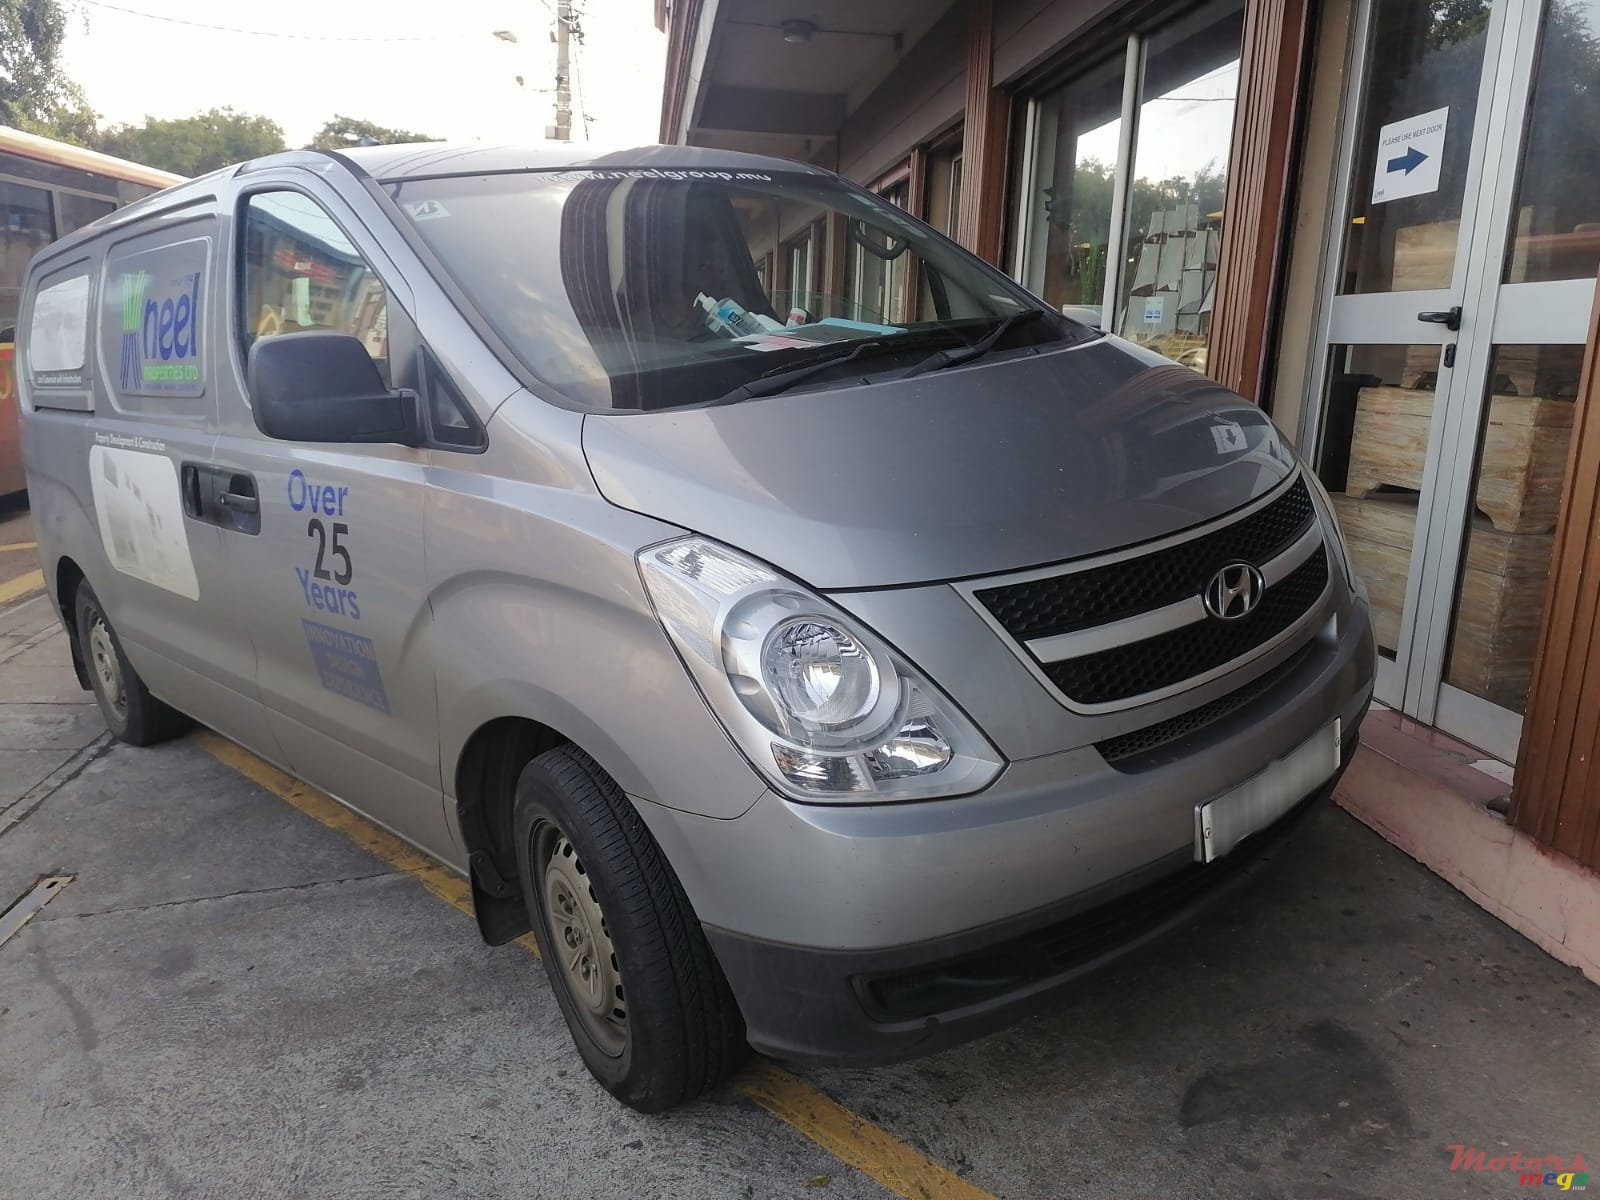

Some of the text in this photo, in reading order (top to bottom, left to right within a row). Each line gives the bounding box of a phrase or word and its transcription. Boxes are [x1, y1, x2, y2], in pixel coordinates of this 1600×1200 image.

[1382, 123, 1443, 146] PLEASE USE NEXT DOOR
[143, 271, 200, 360] neel
[288, 469, 348, 516] Over
[308, 518, 353, 586] 25
[296, 567, 360, 620] Years
